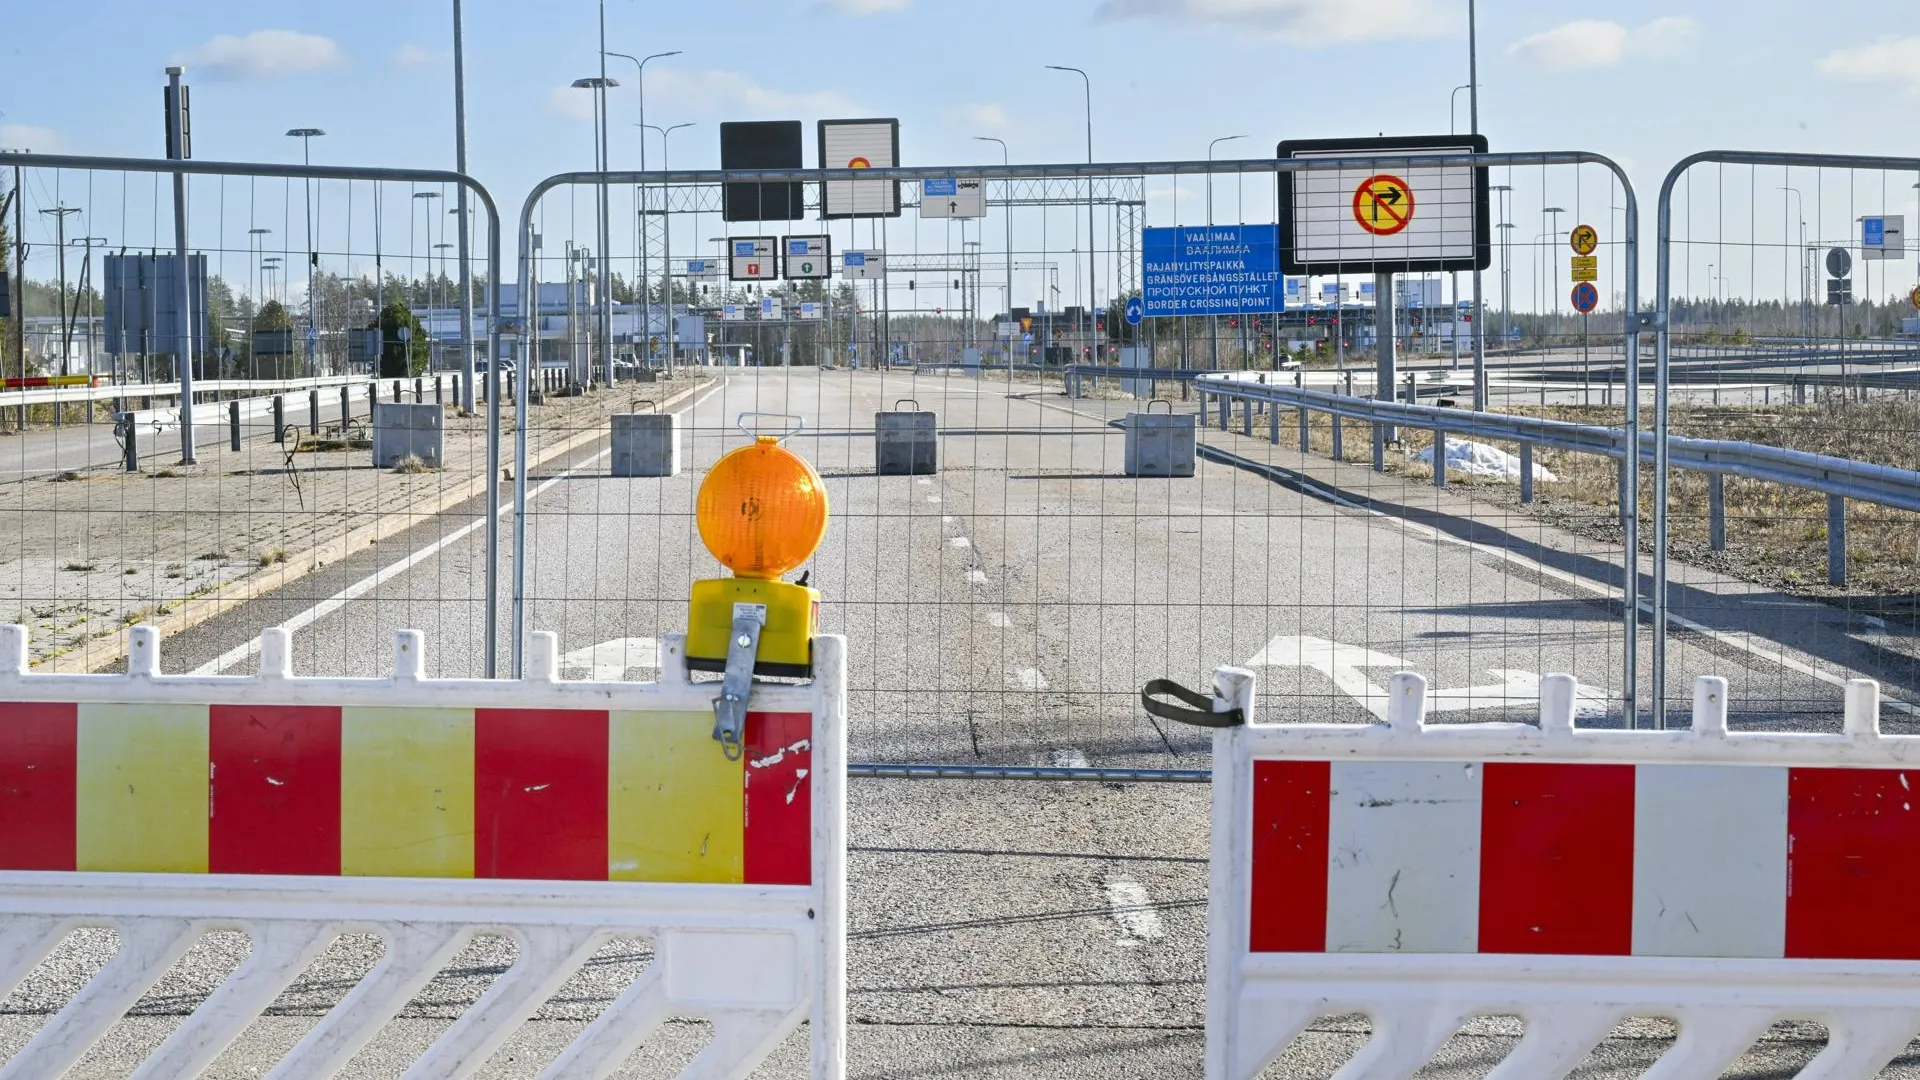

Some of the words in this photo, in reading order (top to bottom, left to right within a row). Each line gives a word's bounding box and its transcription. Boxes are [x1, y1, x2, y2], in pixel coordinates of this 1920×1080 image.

[1186, 232, 1236, 242] VAALIMAA
[1146, 261, 1245, 272] RAJANYLITYSPAIKKA
[1147, 271, 1279, 284] GRÄNSÖVERGÅNGSSTÄLLET
[1147, 284, 1227, 296] ПРОПУСКНОЙ
[1230, 285, 1268, 295] ПУНКТ
[1147, 300, 1187, 310] BORDER
[1190, 298, 1238, 308] CROSSING
[1242, 297, 1271, 306] POINT
